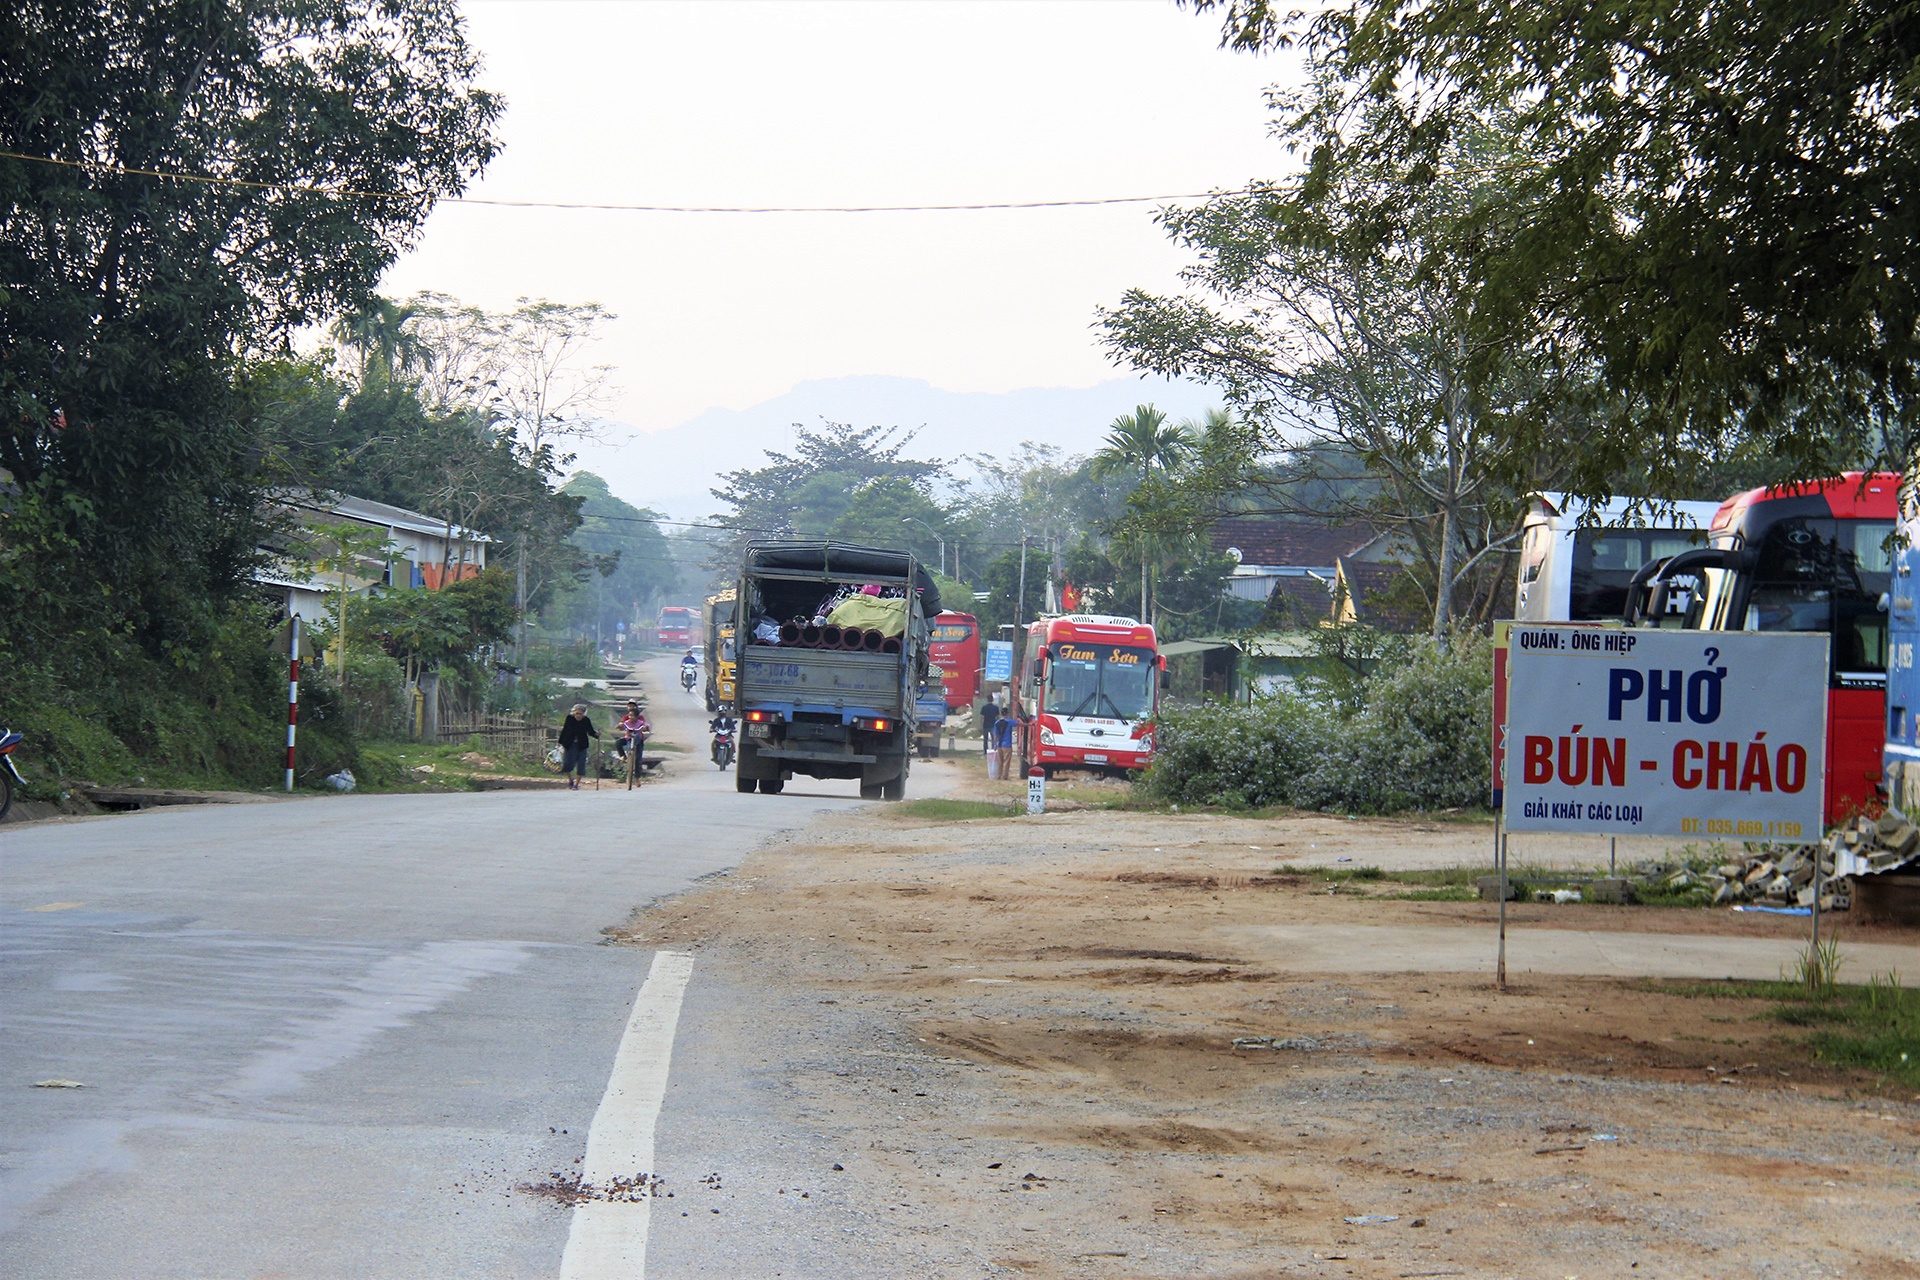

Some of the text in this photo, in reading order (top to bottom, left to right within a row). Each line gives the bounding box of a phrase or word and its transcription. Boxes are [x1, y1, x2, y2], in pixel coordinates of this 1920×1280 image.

[1571, 629, 1601, 651] ÔNG
[1604, 634, 1637, 656] HIỆP
[1109, 648, 1139, 665] Sơn
[1607, 647, 1727, 724] PHỞ
[1523, 724, 1627, 787] BÚN
[1672, 731, 1808, 794] CHÁO
[1030, 795, 1041, 803] 72
[1523, 796, 1643, 825] GIẢI KHÁT CÁC LOẠI
[1707, 819, 1802, 838] 035.669.1159
